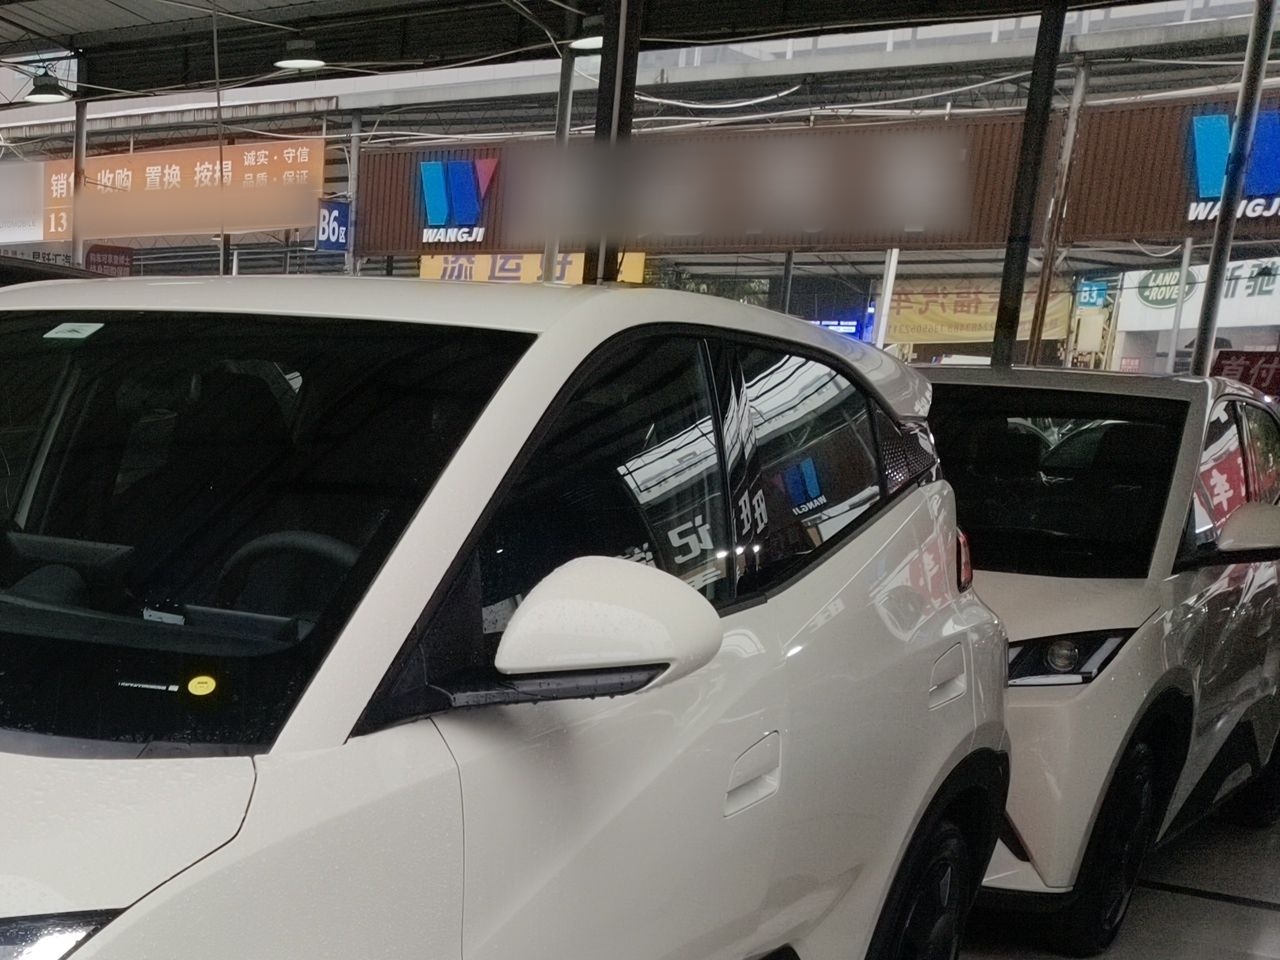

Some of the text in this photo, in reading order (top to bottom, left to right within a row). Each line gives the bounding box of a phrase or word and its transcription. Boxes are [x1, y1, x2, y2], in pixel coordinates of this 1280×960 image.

[50, 161, 232, 198] 销 收购 置换 按揭
[422, 227, 485, 243] WANGJI
[1149, 271, 1180, 287] LAND
[1149, 284, 1188, 301] ROVE
